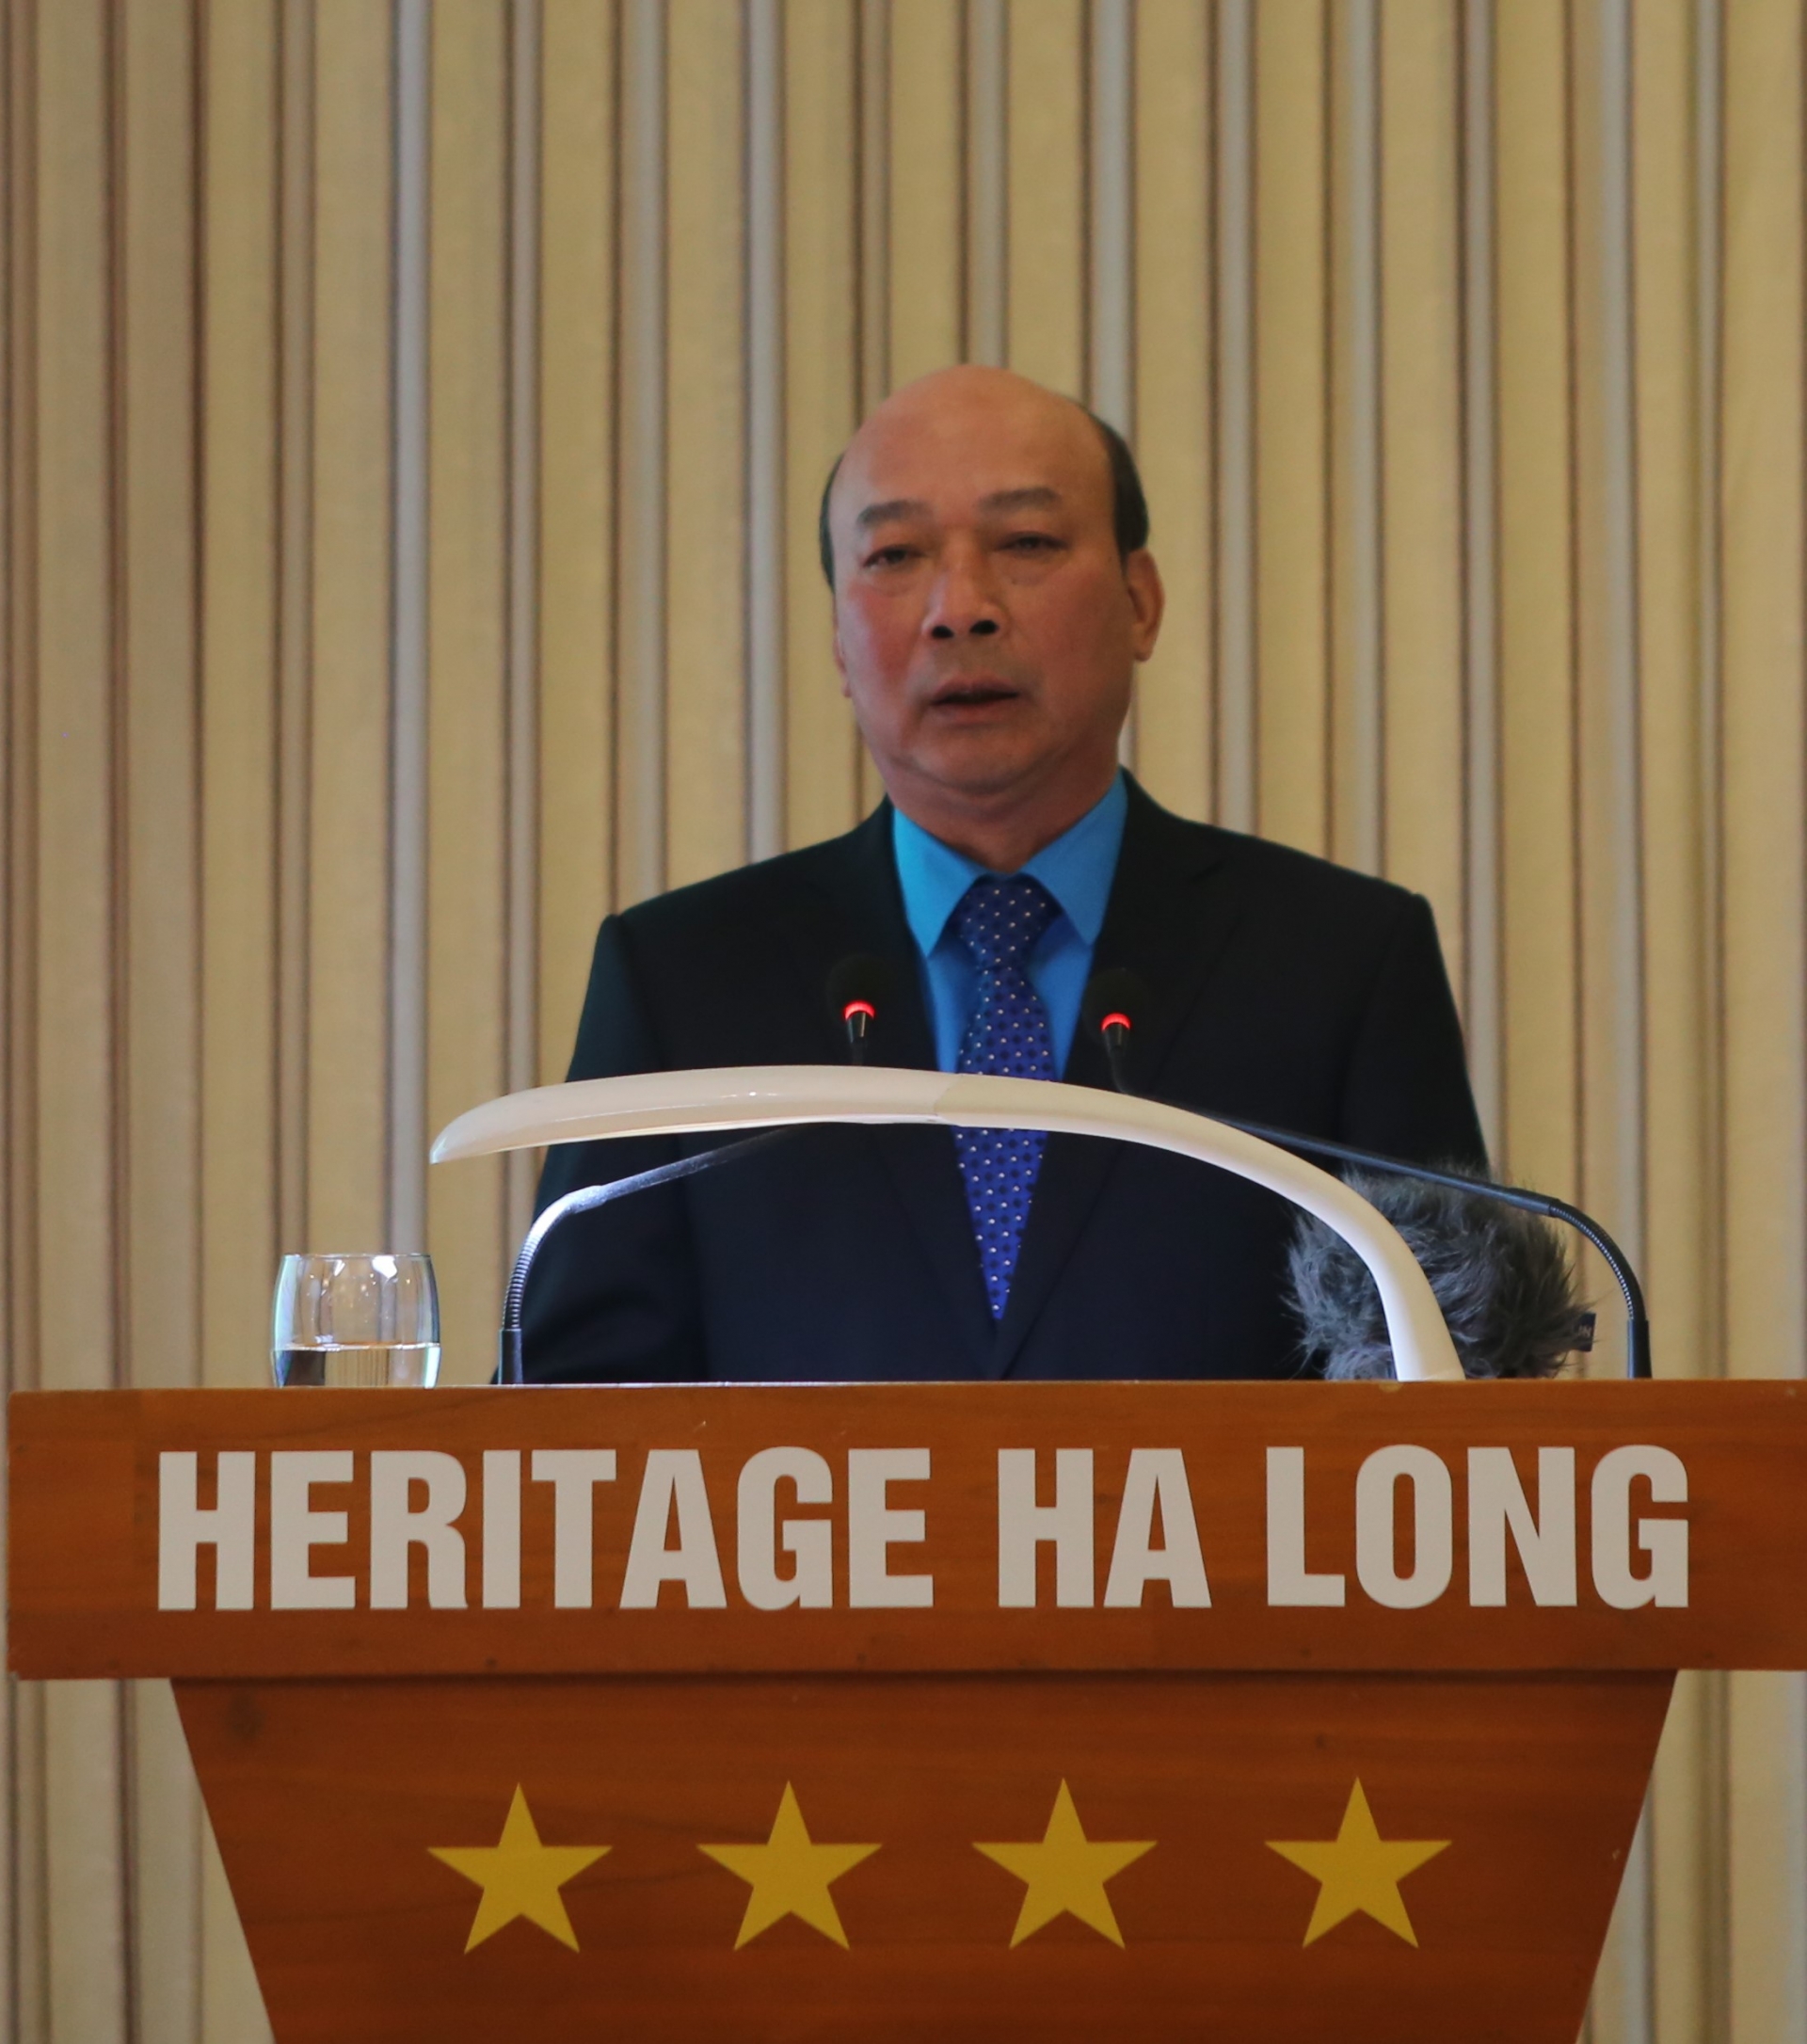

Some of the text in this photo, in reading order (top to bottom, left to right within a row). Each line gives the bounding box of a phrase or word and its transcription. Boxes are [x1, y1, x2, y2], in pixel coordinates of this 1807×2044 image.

[158, 1445, 1689, 1610] HERITAGE HA LONG
